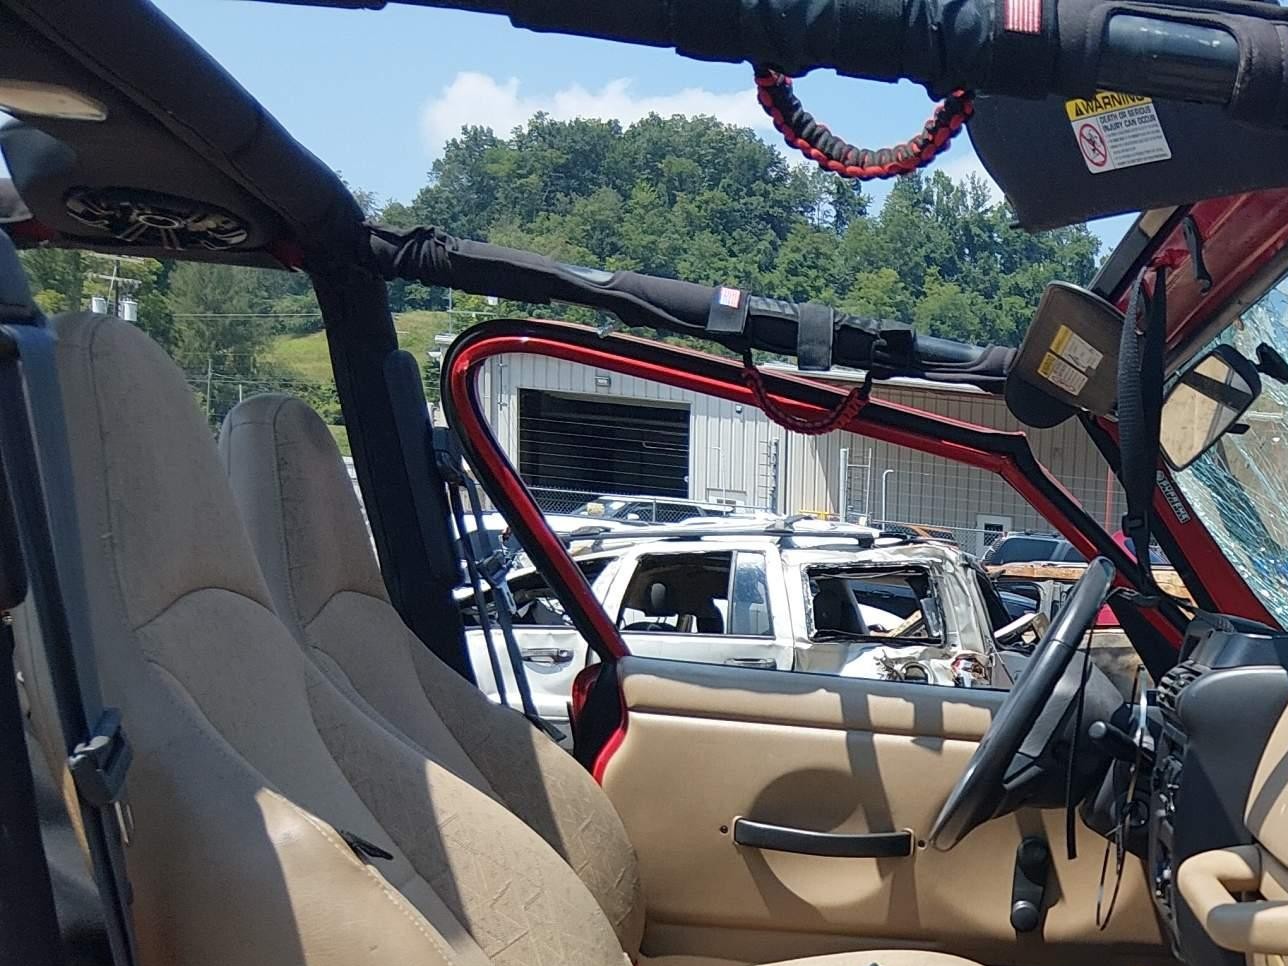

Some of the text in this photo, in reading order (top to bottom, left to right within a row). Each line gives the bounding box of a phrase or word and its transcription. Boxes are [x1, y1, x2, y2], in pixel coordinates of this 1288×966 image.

[1099, 105, 1152, 124] DEATH OR SERIOUS
[1103, 114, 1156, 131] INJURY CAN OCCUR
